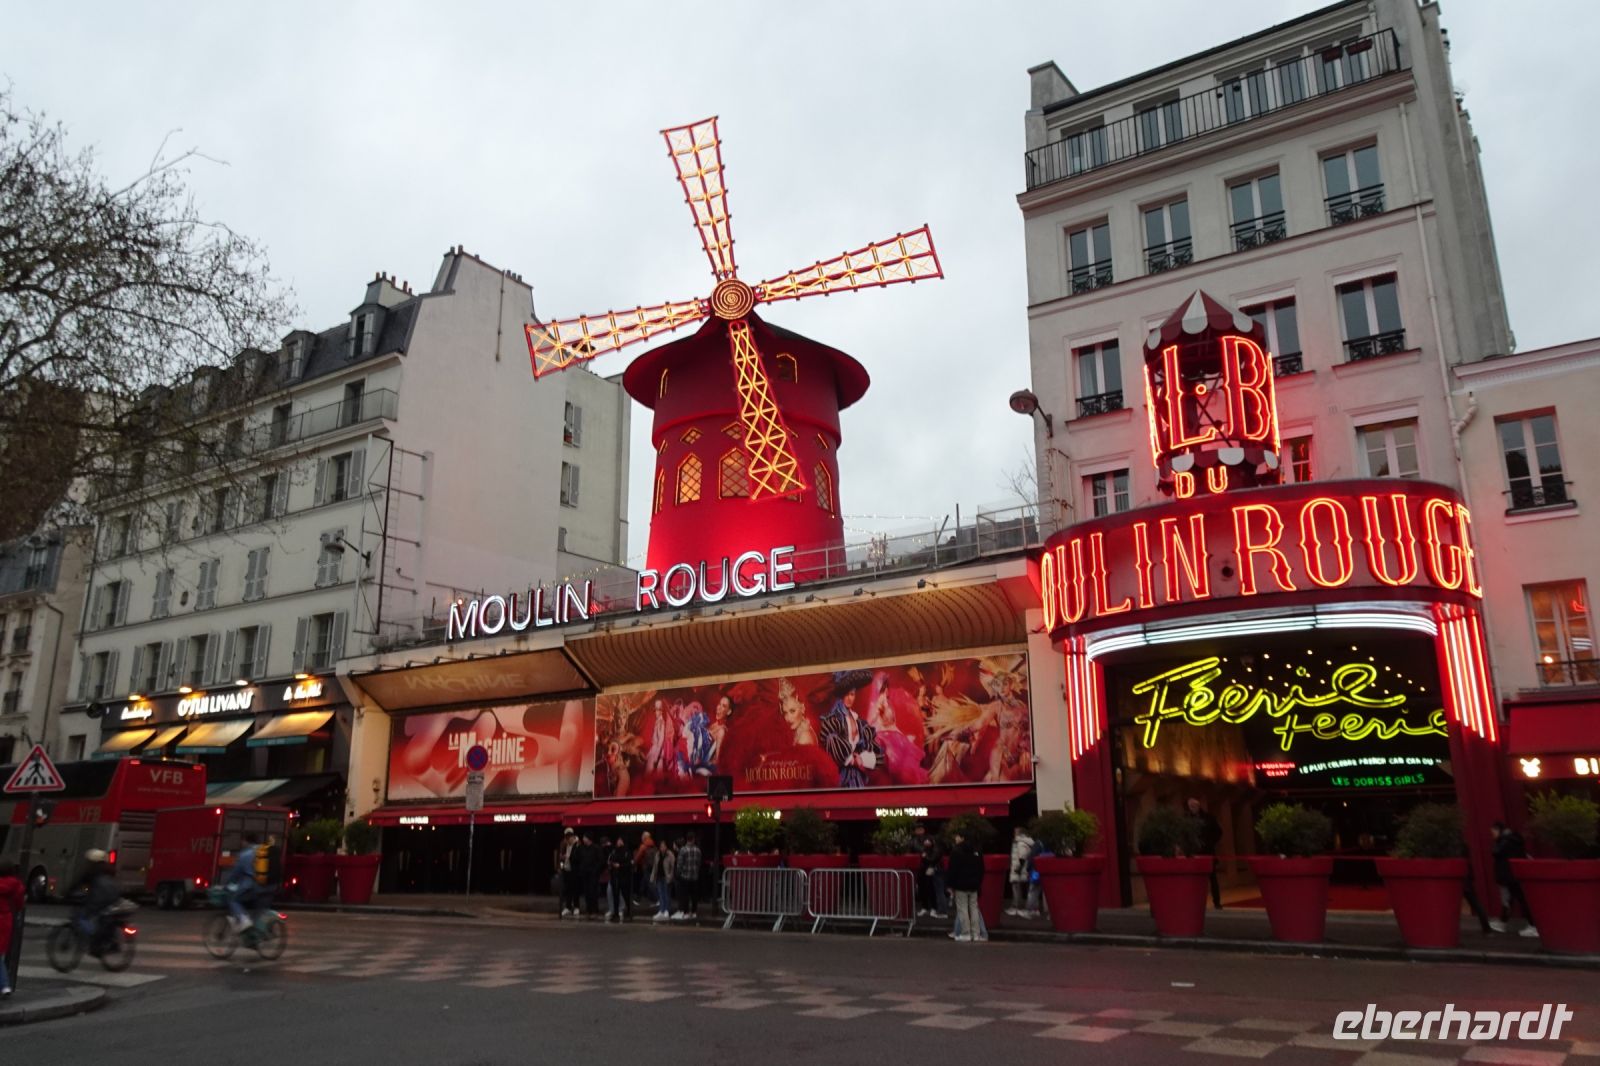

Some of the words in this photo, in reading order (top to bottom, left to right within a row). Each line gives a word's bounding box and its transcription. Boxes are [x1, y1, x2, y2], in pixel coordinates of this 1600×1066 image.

[1175, 466, 1228, 498] DU
[1232, 494, 1483, 599] ROUGE
[449, 580, 591, 639] MOULIN
[636, 545, 796, 611] ROUGE
[150, 769, 183, 785] VFB
[745, 767, 778, 783] MOULIN
[780, 765, 813, 780] ROUGE
[1354, 777, 1392, 787] DORISS
[1394, 774, 1425, 786] GIRLS
